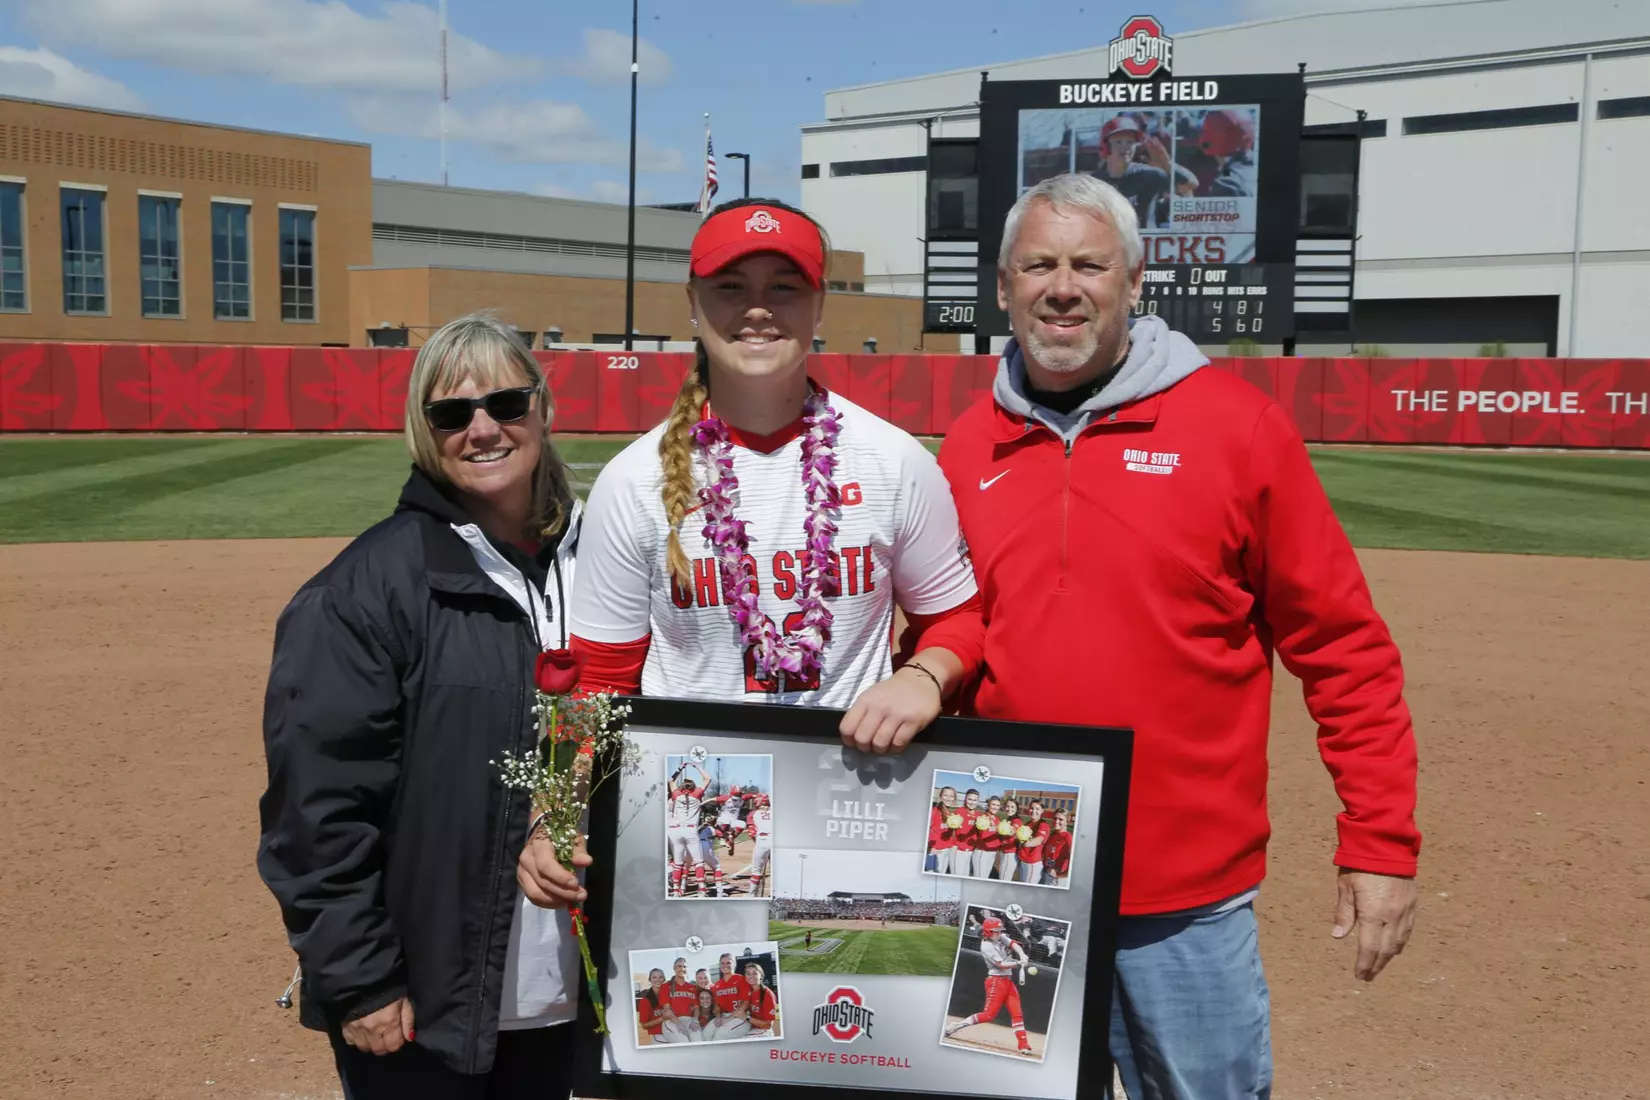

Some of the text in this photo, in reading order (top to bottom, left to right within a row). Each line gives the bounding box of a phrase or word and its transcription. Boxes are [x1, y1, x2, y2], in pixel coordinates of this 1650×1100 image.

[1059, 80, 1219, 103] BUCKEYE FIELD
[1173, 200, 1239, 212] SENIOR
[1173, 213, 1240, 222] SHORTSTOP
[1204, 269, 1228, 283] OUT
[1150, 286, 1157, 296] 7
[939, 306, 975, 323] 2:00
[607, 355, 639, 370] 220
[1390, 390, 1449, 412] THE
[1457, 390, 1586, 414] PEOPLE.
[1123, 448, 1181, 466] OHIO STATE
[832, 799, 886, 821] LILLI
[825, 819, 889, 841] PIPER
[812, 1001, 874, 1040] OHIO STATE
[769, 1049, 912, 1069] BUCKEYE SOFTBALL
